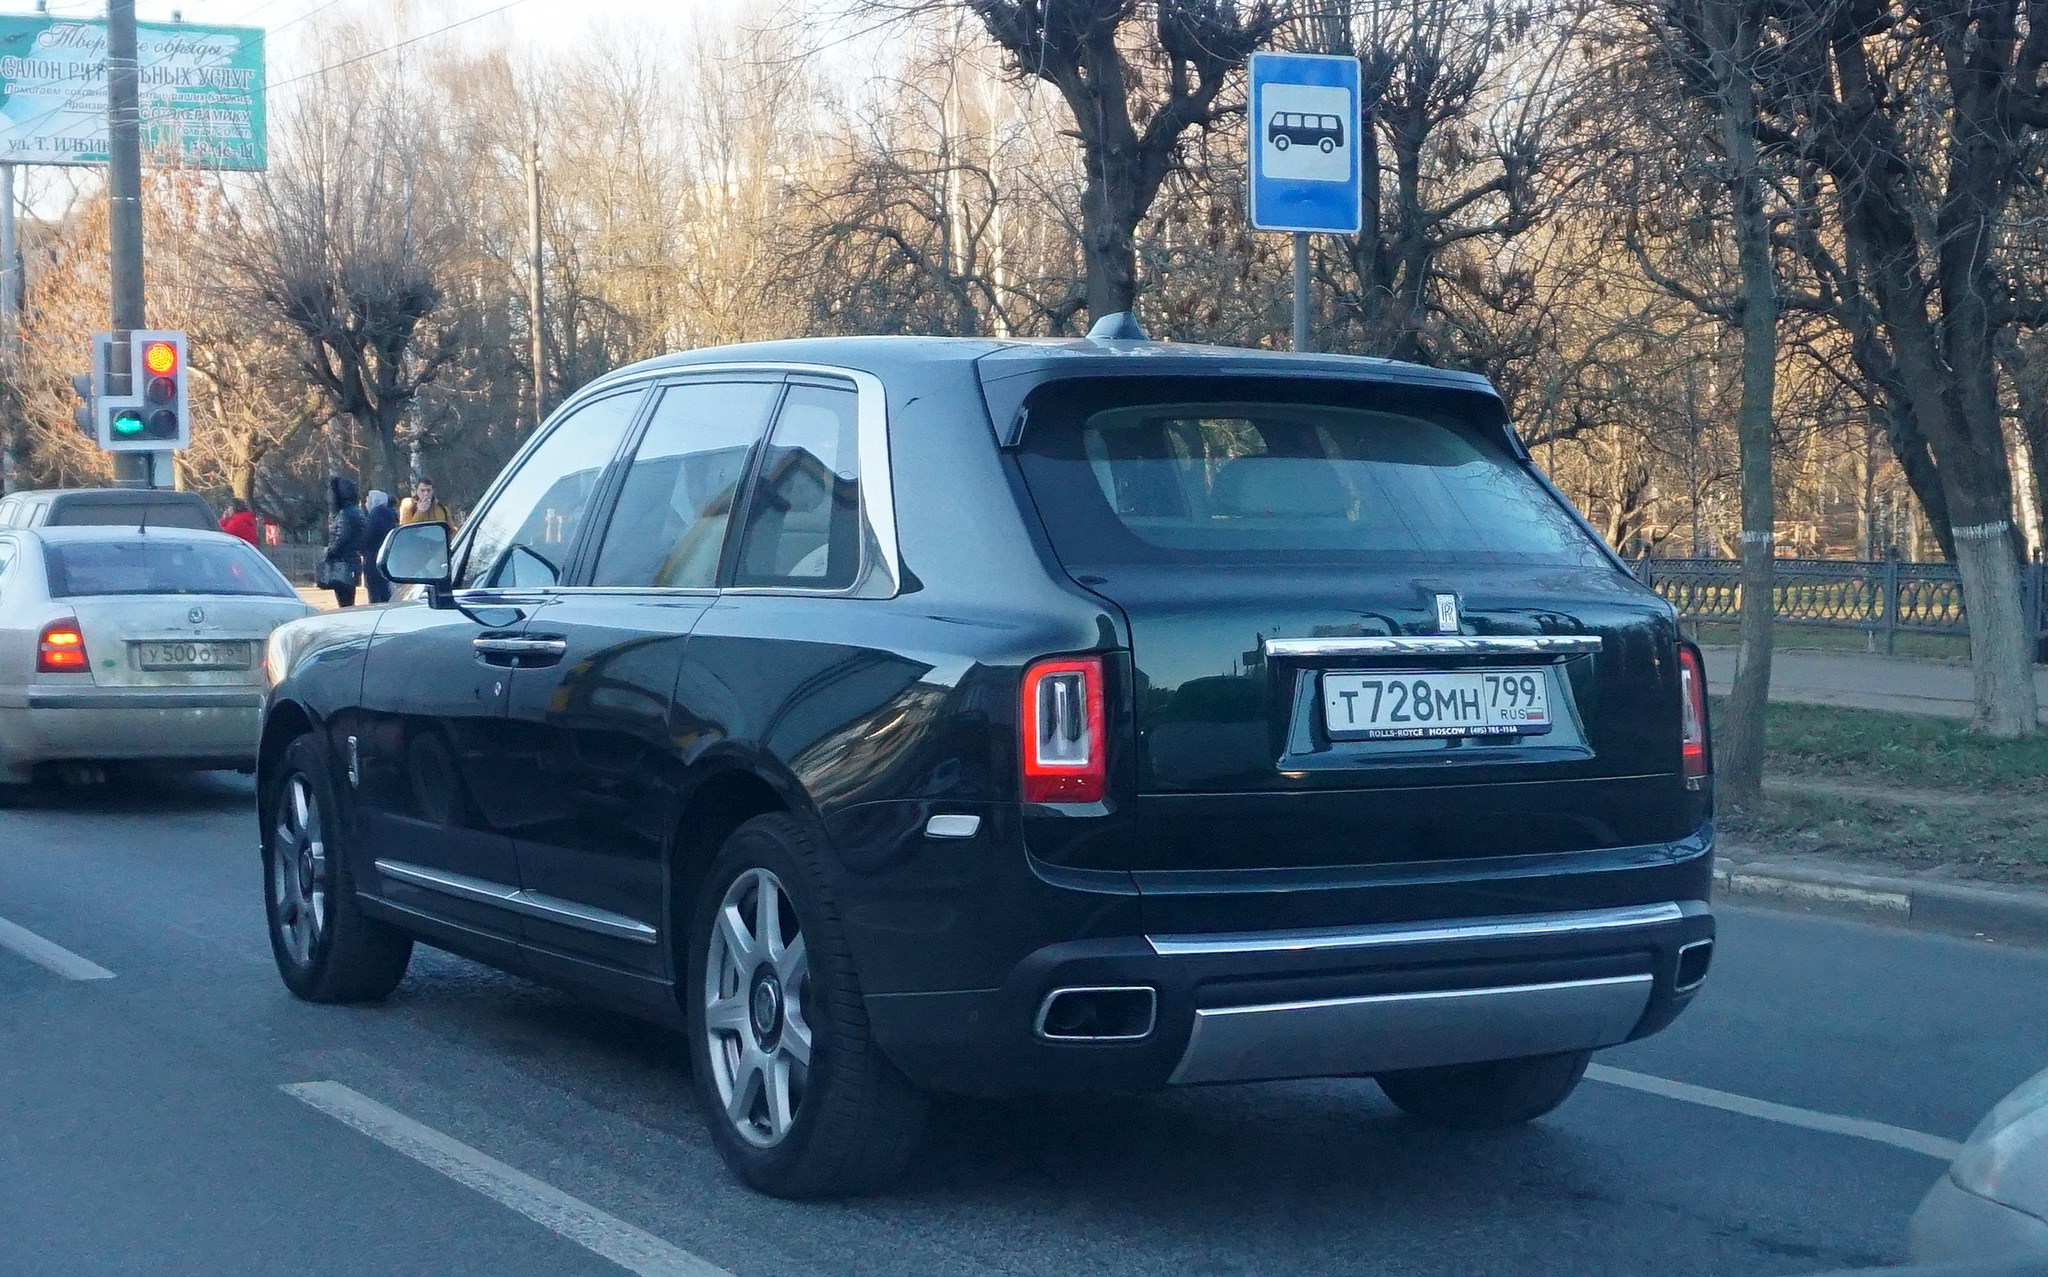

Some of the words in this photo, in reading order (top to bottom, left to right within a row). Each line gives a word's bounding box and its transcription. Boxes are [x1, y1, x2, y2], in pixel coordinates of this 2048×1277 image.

[38, 22, 148, 58] Твере
[154, 32, 222, 65] обряды
[1, 56, 62, 80] САЛОН
[69, 61, 190, 86] РИТЬНЫХ
[198, 67, 256, 89] УСЛУГ
[5, 83, 60, 96] Помогаем
[1339, 680, 1481, 724] Т728МН
[1485, 676, 1536, 708] 799
[1500, 707, 1526, 720] RUS
[1369, 728, 1424, 738] ROLLS-ROYCE
[1429, 727, 1466, 736] MOSCOW
